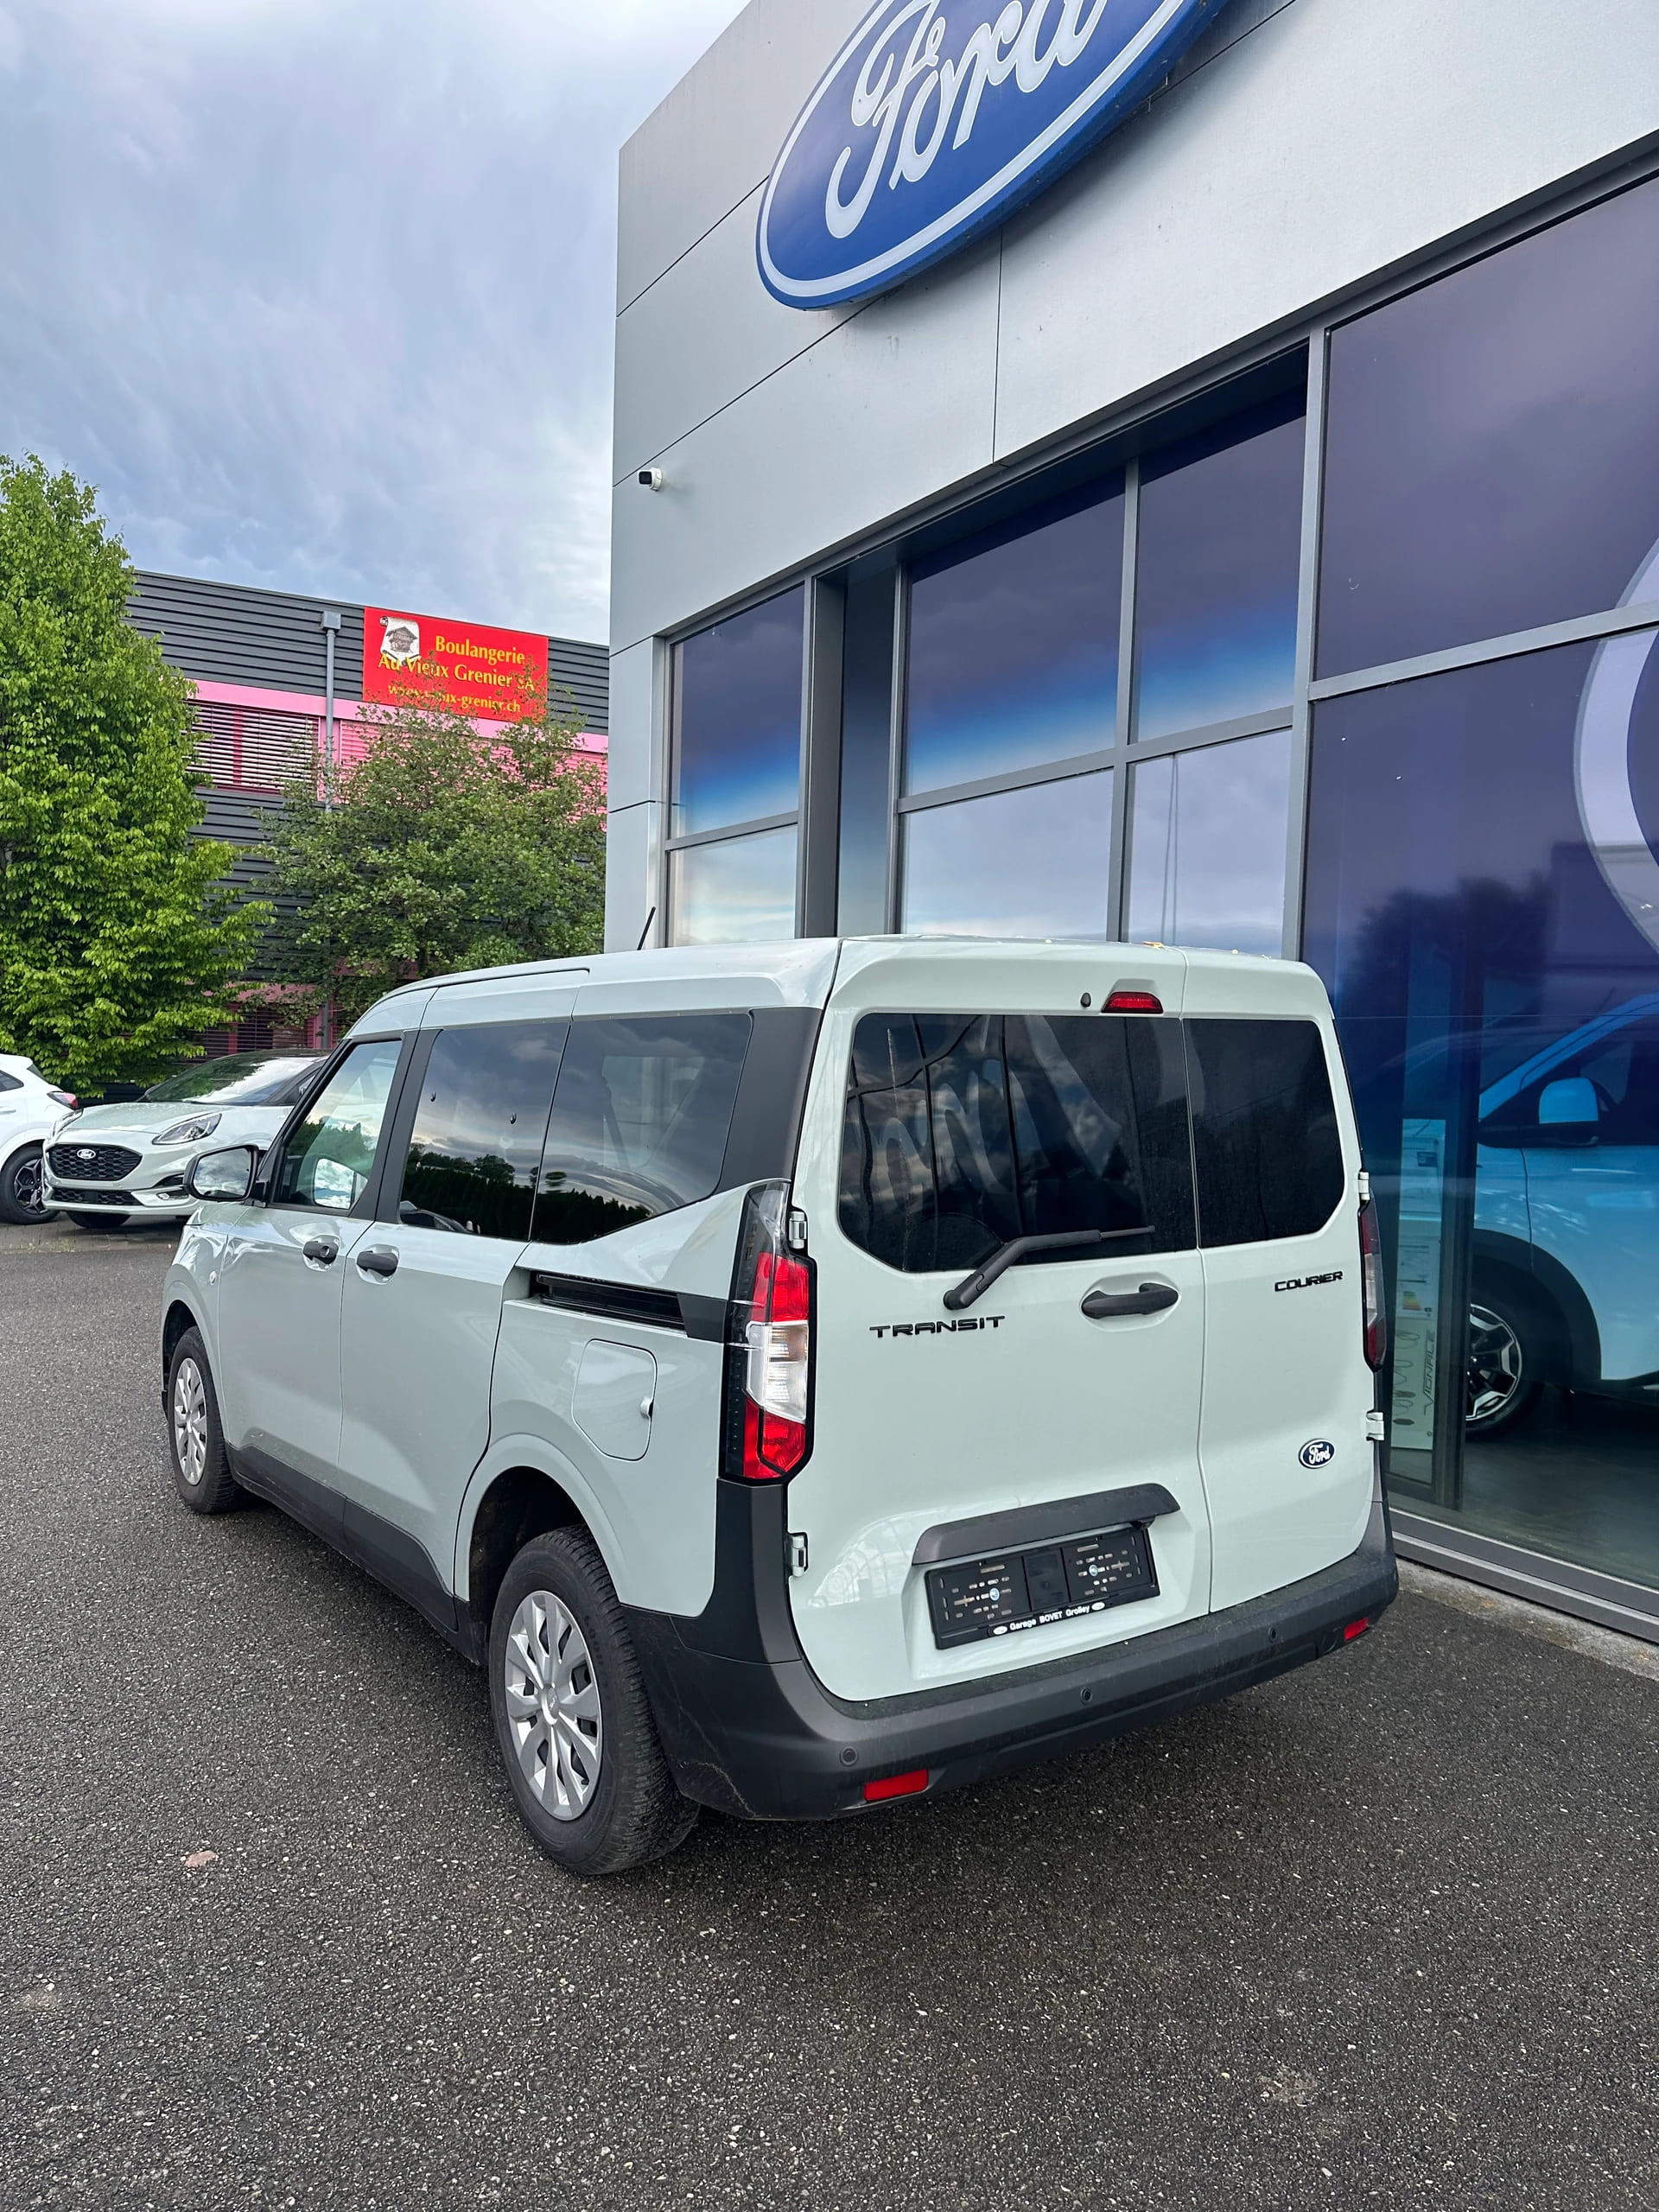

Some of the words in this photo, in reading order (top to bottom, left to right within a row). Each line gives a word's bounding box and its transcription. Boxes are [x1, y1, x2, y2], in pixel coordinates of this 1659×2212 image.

[435, 635, 525, 665] Boulangerie
[378, 652, 400, 671] Au
[405, 655, 449, 678] Vieux
[454, 664, 513, 687] Grenier
[388, 685, 521, 713] www.vux-grenier.ch
[1274, 1270, 1344, 1292] COURIER
[869, 1315, 1006, 1338] TRANSIT
[1308, 1443, 1331, 1465] Ford
[1009, 1618, 1037, 1630] Garage
[1039, 1611, 1063, 1624] BOVET
[1065, 1605, 1090, 1618] Grolley
